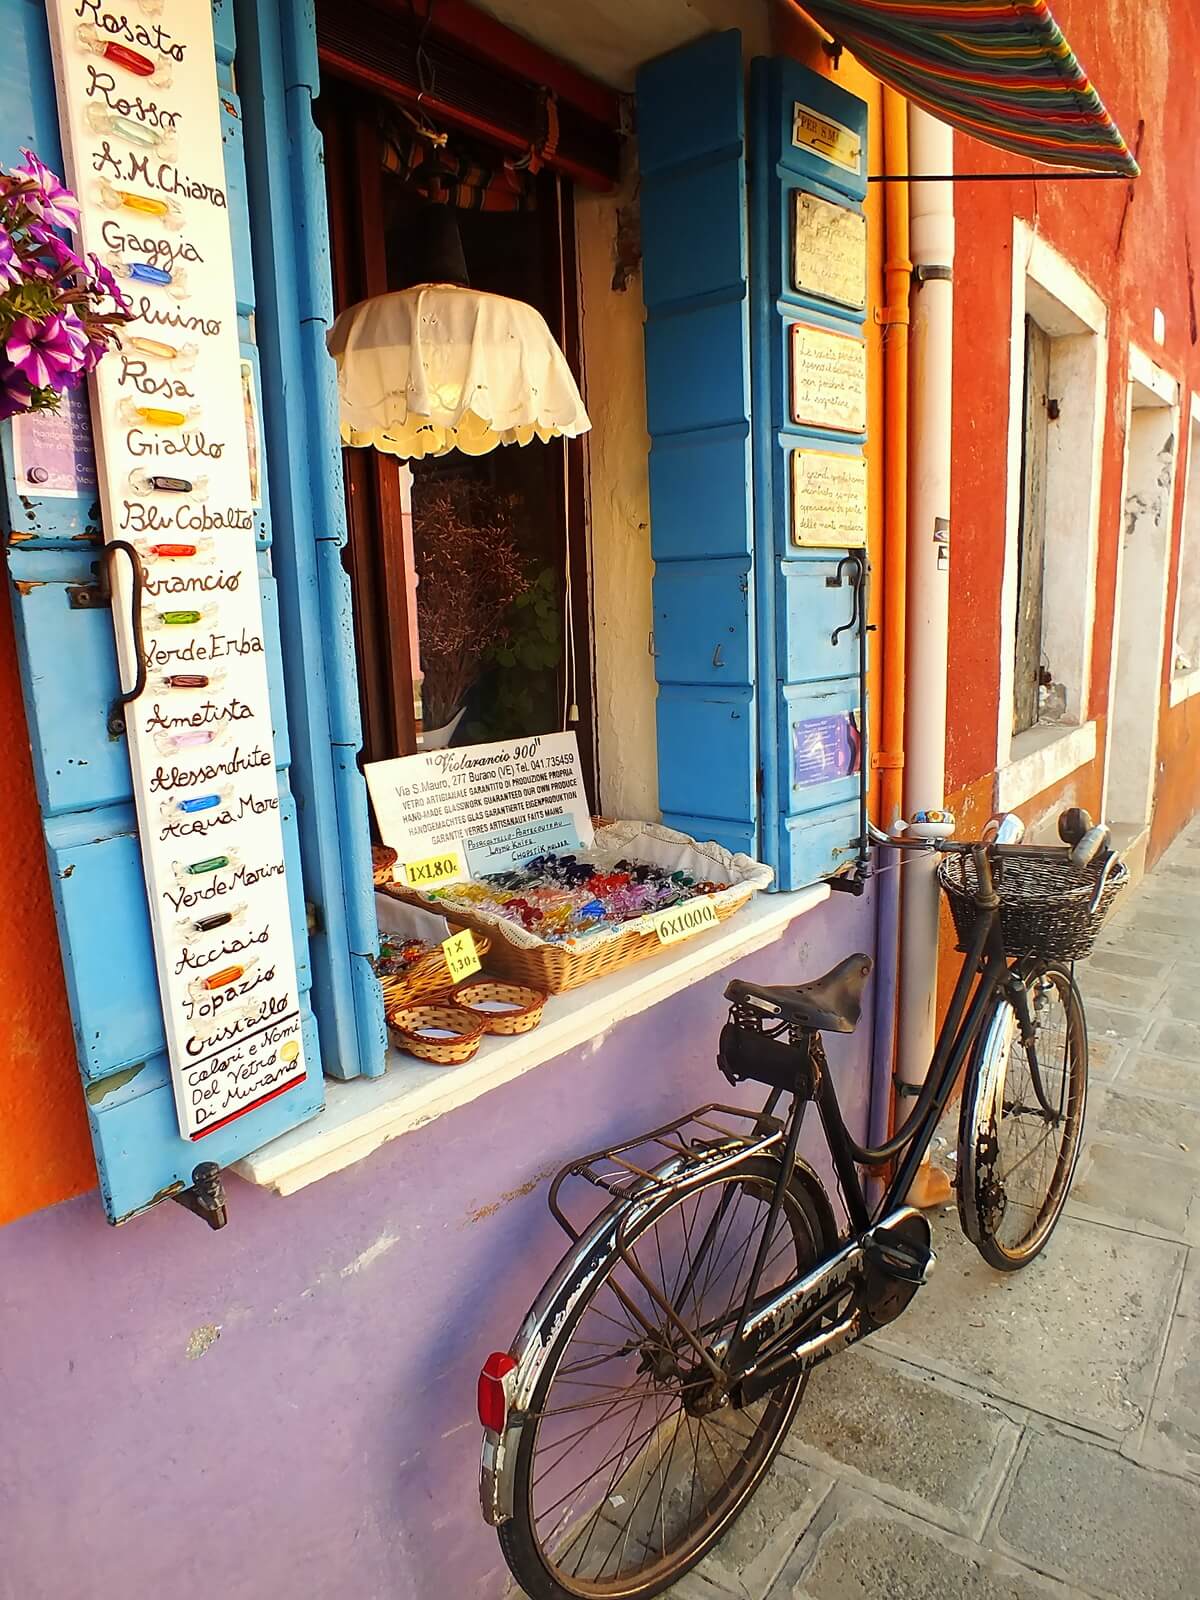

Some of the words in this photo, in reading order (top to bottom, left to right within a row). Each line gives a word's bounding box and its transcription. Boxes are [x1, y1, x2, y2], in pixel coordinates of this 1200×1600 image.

[75, 0, 187, 62] Rosato
[86, 65, 182, 130] Rosso
[102, 220, 205, 272] Gaggia
[118, 356, 195, 398] Rosa
[126, 428, 225, 459] Giallo
[120, 500, 173, 531] Blu
[175, 504, 252, 531] Cobalto
[208, 627, 264, 660] Erba
[145, 698, 254, 733] Ametista
[150, 744, 272, 793] Alessandrite
[395, 785, 411, 798] Via
[452, 772, 467, 786] 277
[469, 770, 497, 782] Burano
[498, 764, 515, 779] (VE)
[530, 753, 574, 771] 041.735459
[403, 797, 425, 810] VETRO
[427, 788, 468, 805] ARTIGIANALE
[469, 782, 504, 796] GARANTITO
[512, 773, 549, 787] PRODUZIONE
[548, 768, 574, 779] PROPRIA
[160, 809, 237, 841] Acqua
[237, 793, 279, 818] Mare
[409, 816, 467, 836] HANDGEMACHTES
[467, 812, 484, 822] GLAS
[484, 803, 525, 818] GARANTIERTE
[525, 791, 578, 809] EIGENPRODUKTION
[444, 799, 482, 814] GLASSWORK
[483, 791, 523, 805] GUARANTEED
[523, 787, 536, 796] OUR
[536, 784, 551, 794] OWN
[551, 778, 578, 791] PRODUCE
[431, 829, 464, 845] GARANTIE
[464, 823, 489, 837] VERRES
[489, 816, 527, 830] ARTISANAUX
[527, 811, 545, 821] FAITS
[544, 806, 564, 817] MAINS
[163, 875, 227, 912] Verde
[228, 861, 285, 891] Marino
[175, 924, 269, 975] Acciaio
[182, 964, 276, 1020] Topazio
[249, 1044, 258, 1055] e
[261, 1018, 301, 1047] Nomi
[192, 1080, 221, 1105] Del
[227, 1050, 277, 1084] Vetro
[195, 1104, 217, 1124] Di
[222, 1052, 300, 1108] Murano
